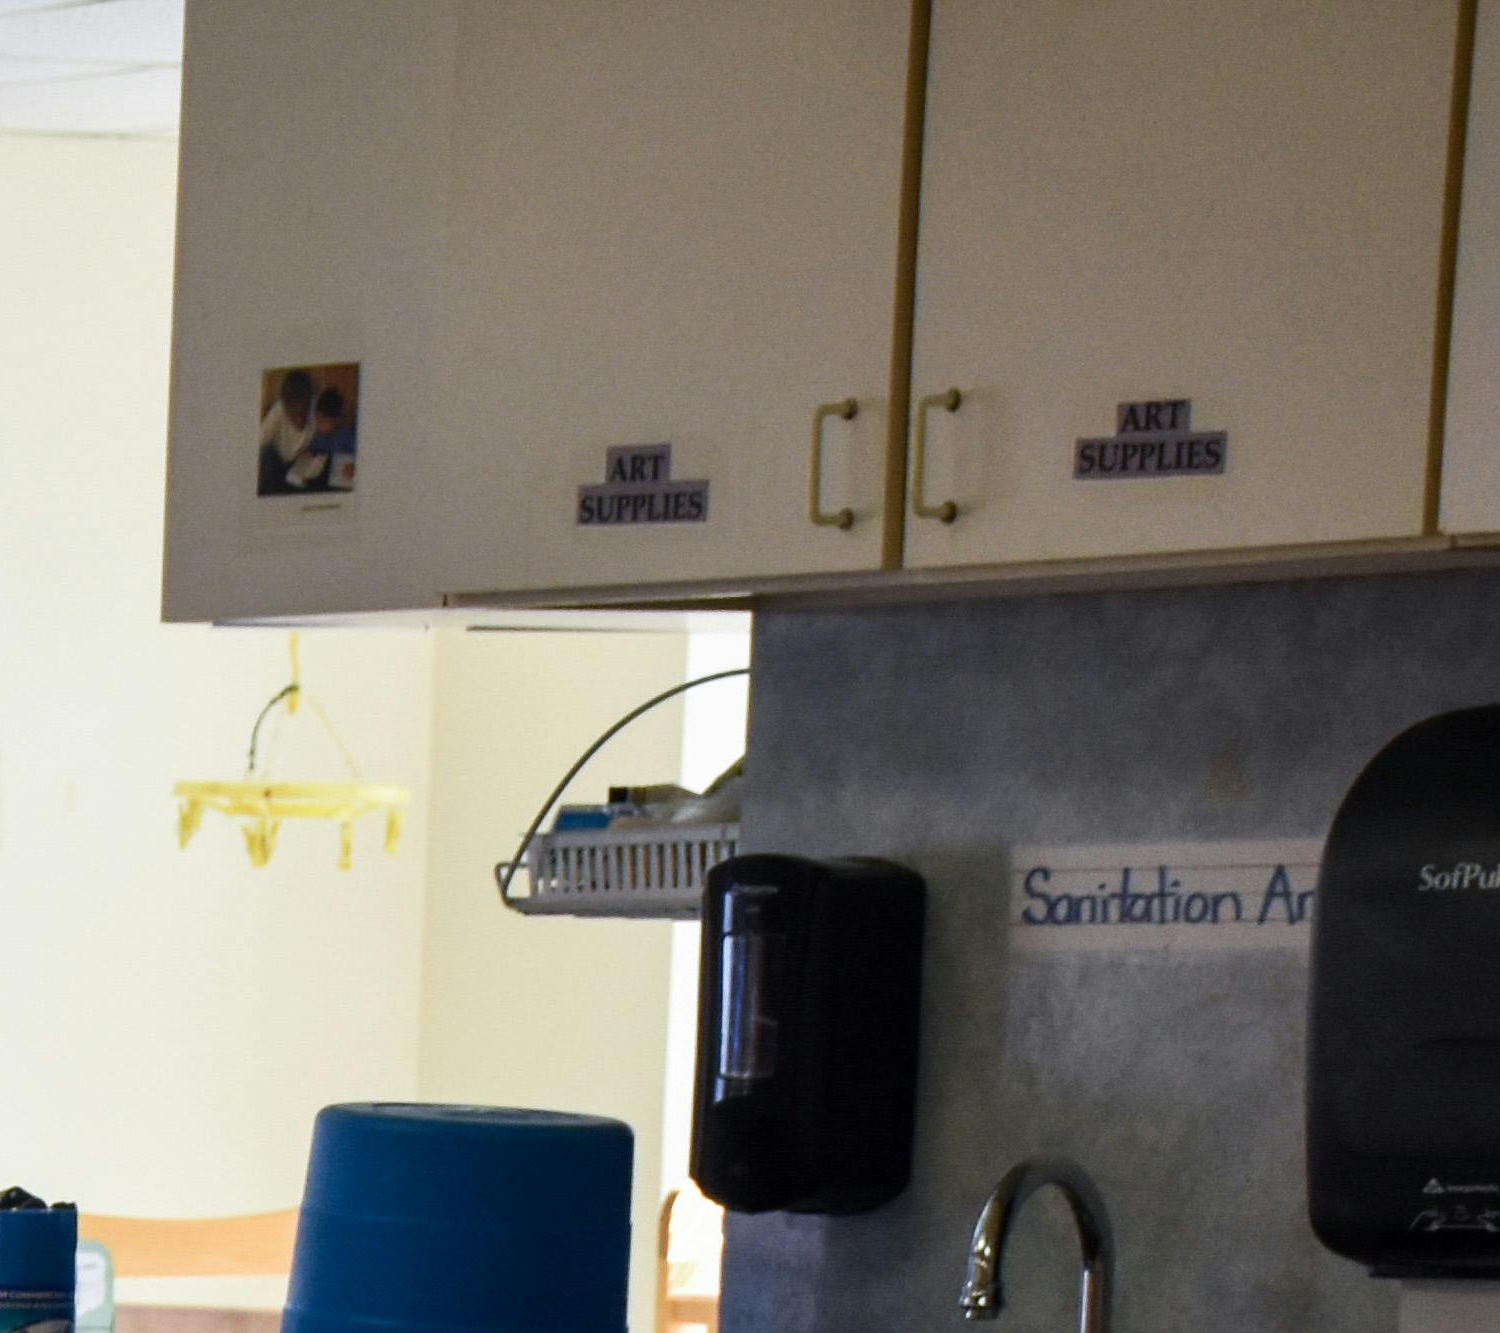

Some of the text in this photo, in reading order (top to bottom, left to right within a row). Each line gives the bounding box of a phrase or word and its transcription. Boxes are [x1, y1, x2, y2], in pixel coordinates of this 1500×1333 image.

[1120, 400, 1181, 432] ART
[609, 453, 664, 484] ART
[1077, 435, 1222, 471] SUPPLIES
[579, 488, 702, 523] SUPPLIES
[1021, 865, 1244, 925] Sanitation
